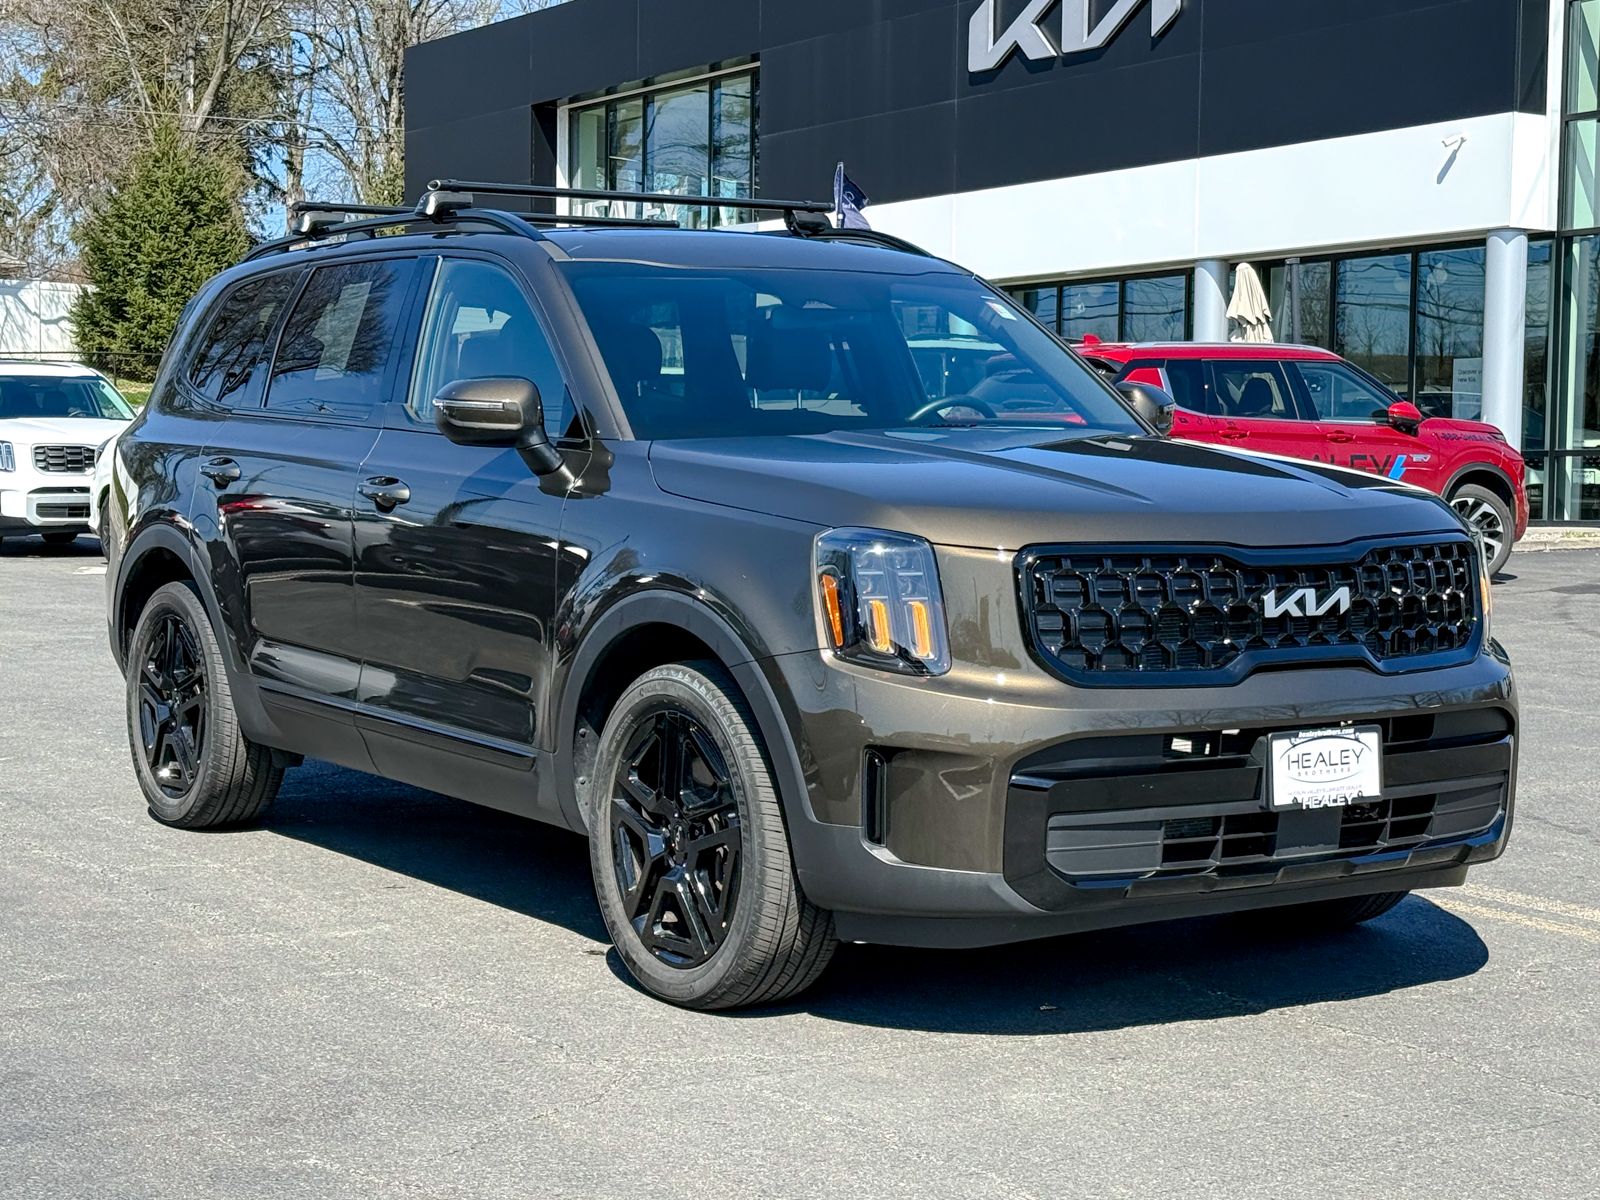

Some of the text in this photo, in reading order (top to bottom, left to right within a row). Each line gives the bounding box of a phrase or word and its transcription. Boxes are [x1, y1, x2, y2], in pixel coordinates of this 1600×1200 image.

[1263, 587, 1350, 618] KIA
[1287, 747, 1364, 771] HEALEY
[1297, 766, 1351, 777] BROTHERS
[1302, 793, 1353, 810] HEALEY
